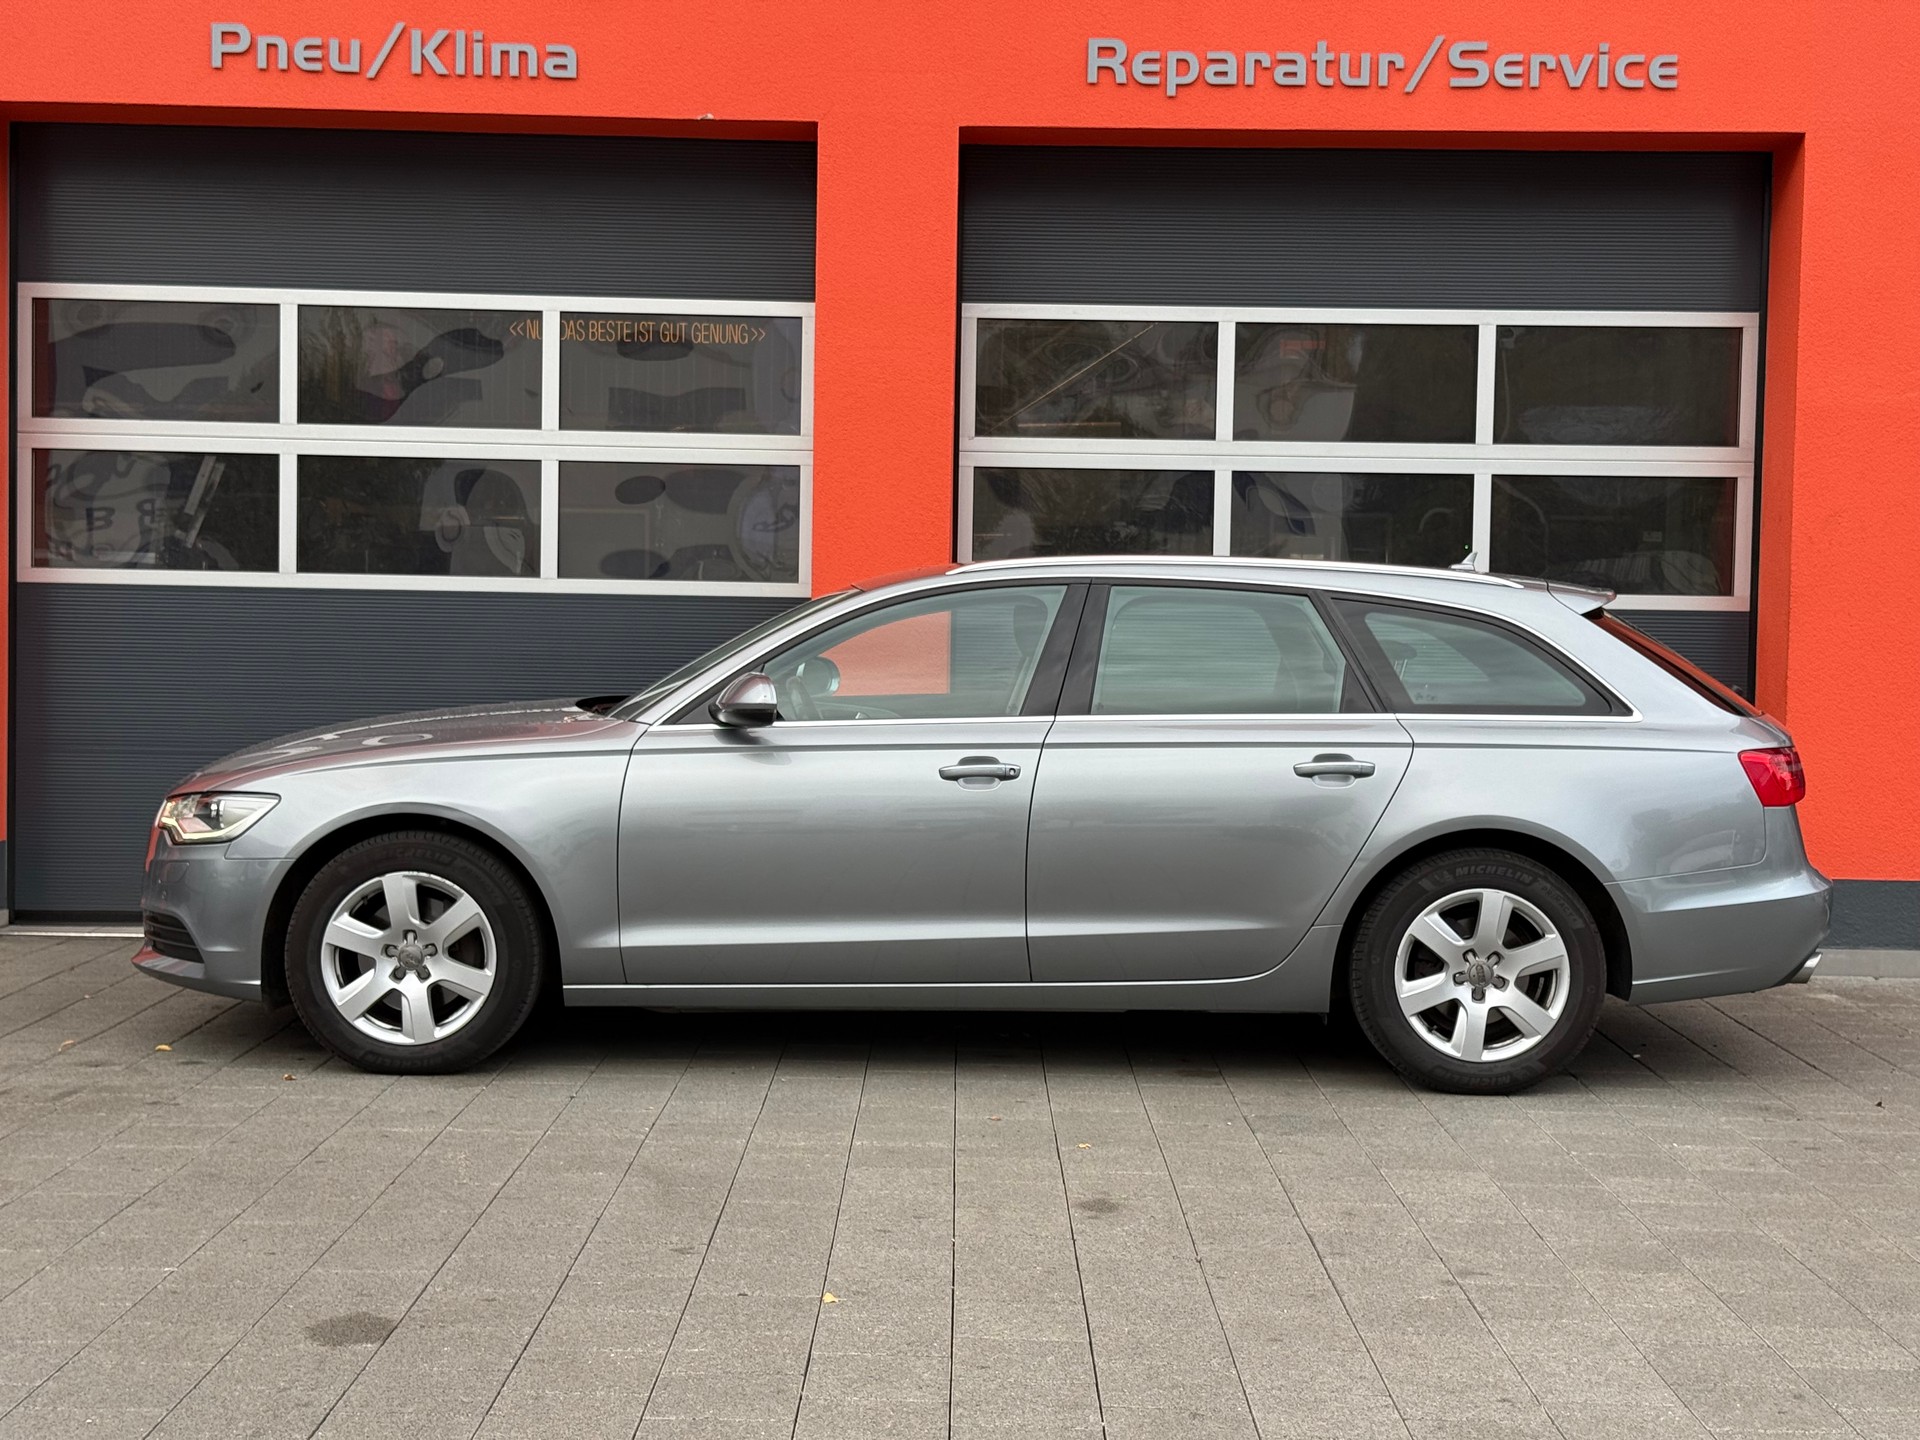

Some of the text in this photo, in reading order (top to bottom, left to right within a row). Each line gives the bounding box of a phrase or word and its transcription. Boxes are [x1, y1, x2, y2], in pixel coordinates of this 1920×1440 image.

[210, 22, 577, 79] Pneu/Klima
[1086, 35, 1679, 97] Reparatur/Service
[588, 320, 632, 342] BESTE
[634, 321, 656, 343] IST
[659, 321, 688, 343] GUT
[1455, 864, 1533, 884] MICHELIN
